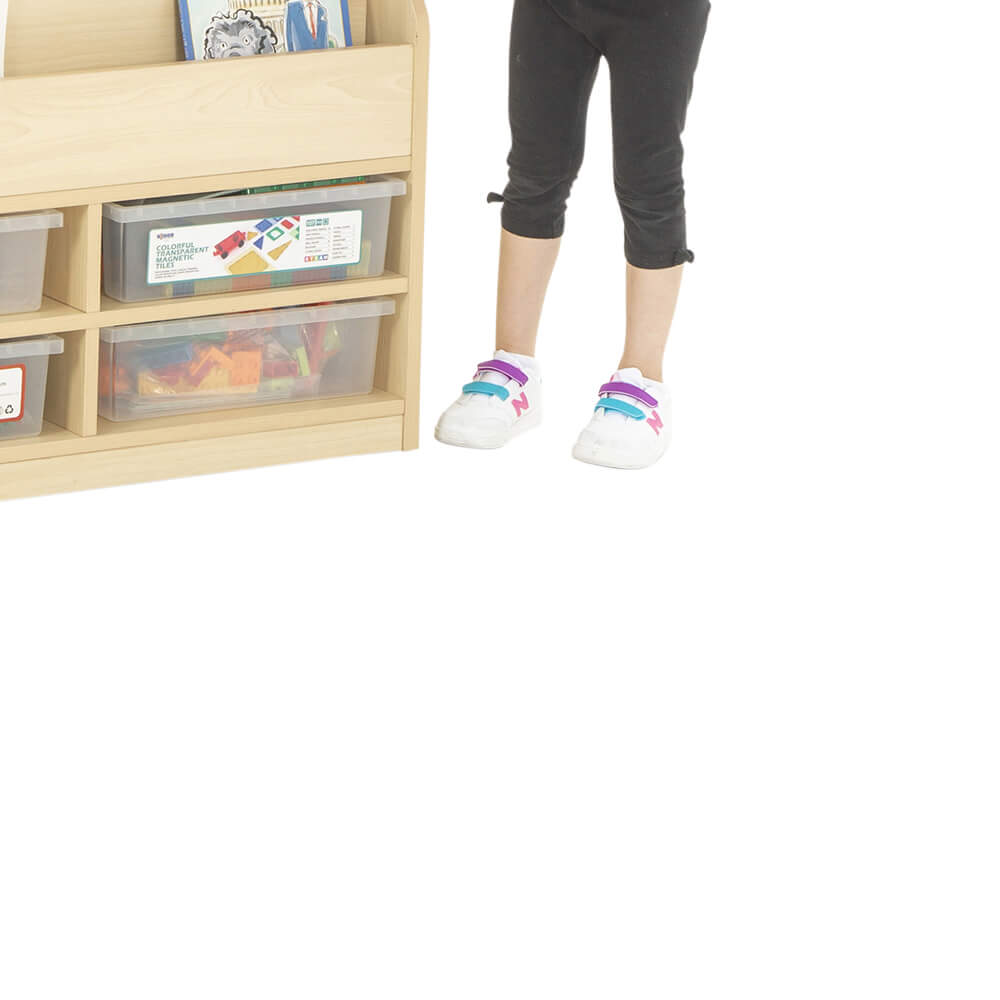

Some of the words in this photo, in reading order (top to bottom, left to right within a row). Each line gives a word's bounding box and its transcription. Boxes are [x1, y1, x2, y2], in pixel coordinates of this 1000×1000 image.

[156, 242, 195, 252] COLORFUL
[156, 246, 210, 258] TRANSPARENT
[155, 254, 195, 264] MAGNETIC
[156, 262, 175, 270] TILES
